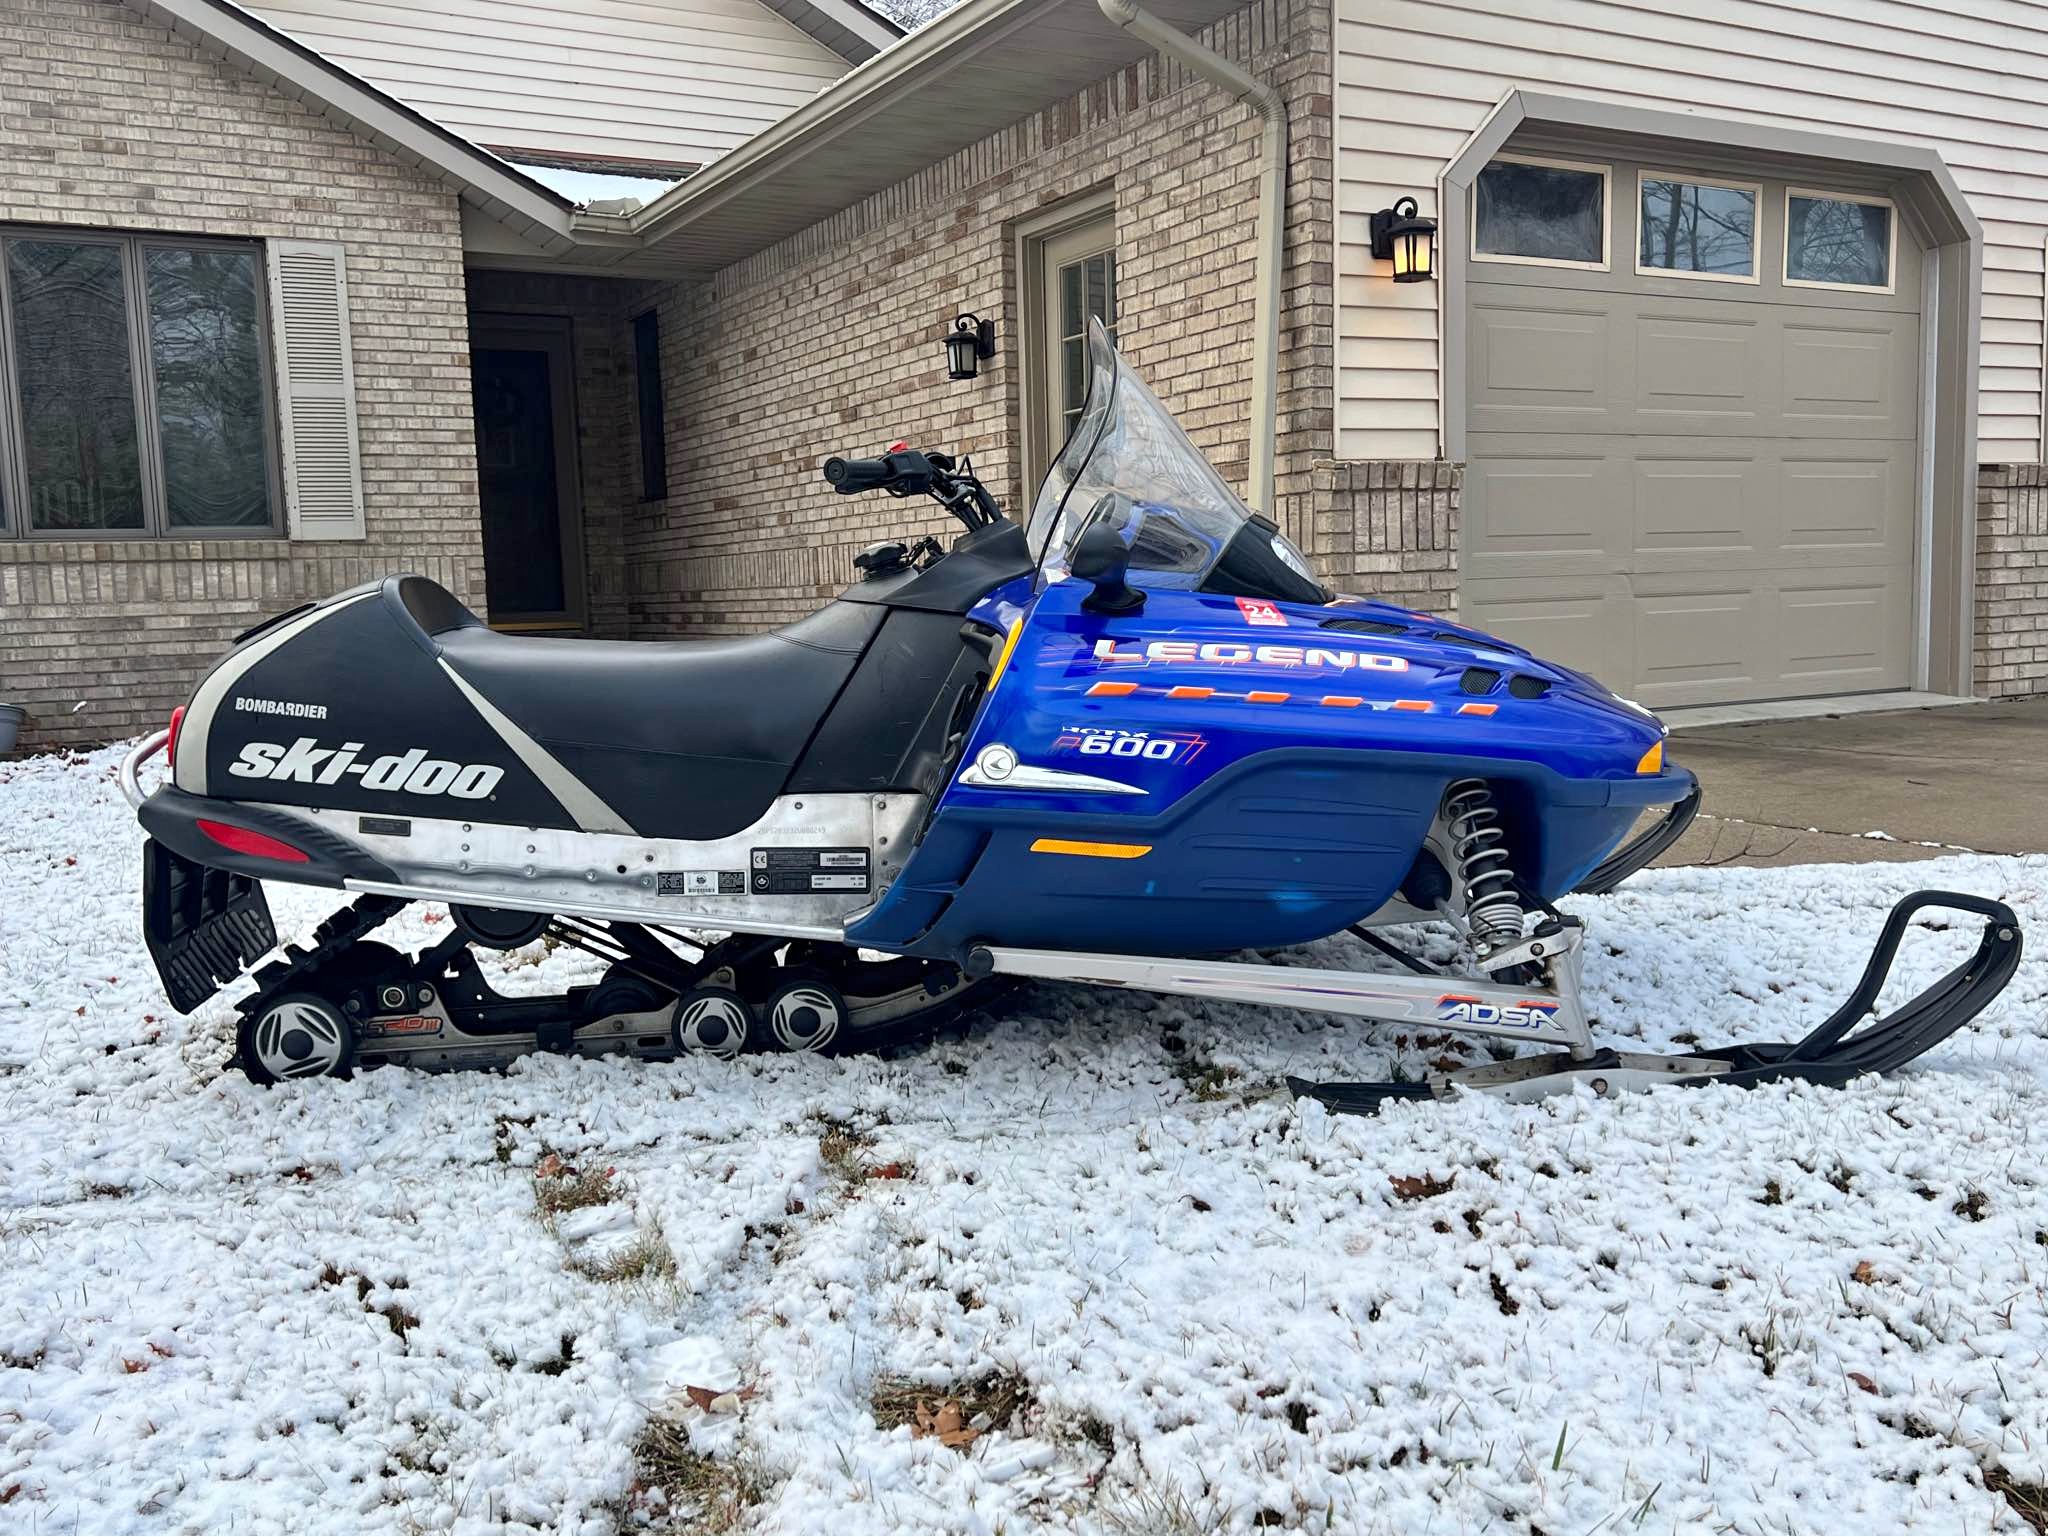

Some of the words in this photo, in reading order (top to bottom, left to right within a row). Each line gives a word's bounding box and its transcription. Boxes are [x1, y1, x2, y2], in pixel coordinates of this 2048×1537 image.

[1245, 605, 1277, 619] 24
[1093, 639, 1409, 673] LEGEND
[235, 697, 328, 719] BOMBARDIER
[1080, 735, 1177, 760] 600
[1438, 1003, 1567, 1032] ADSA
